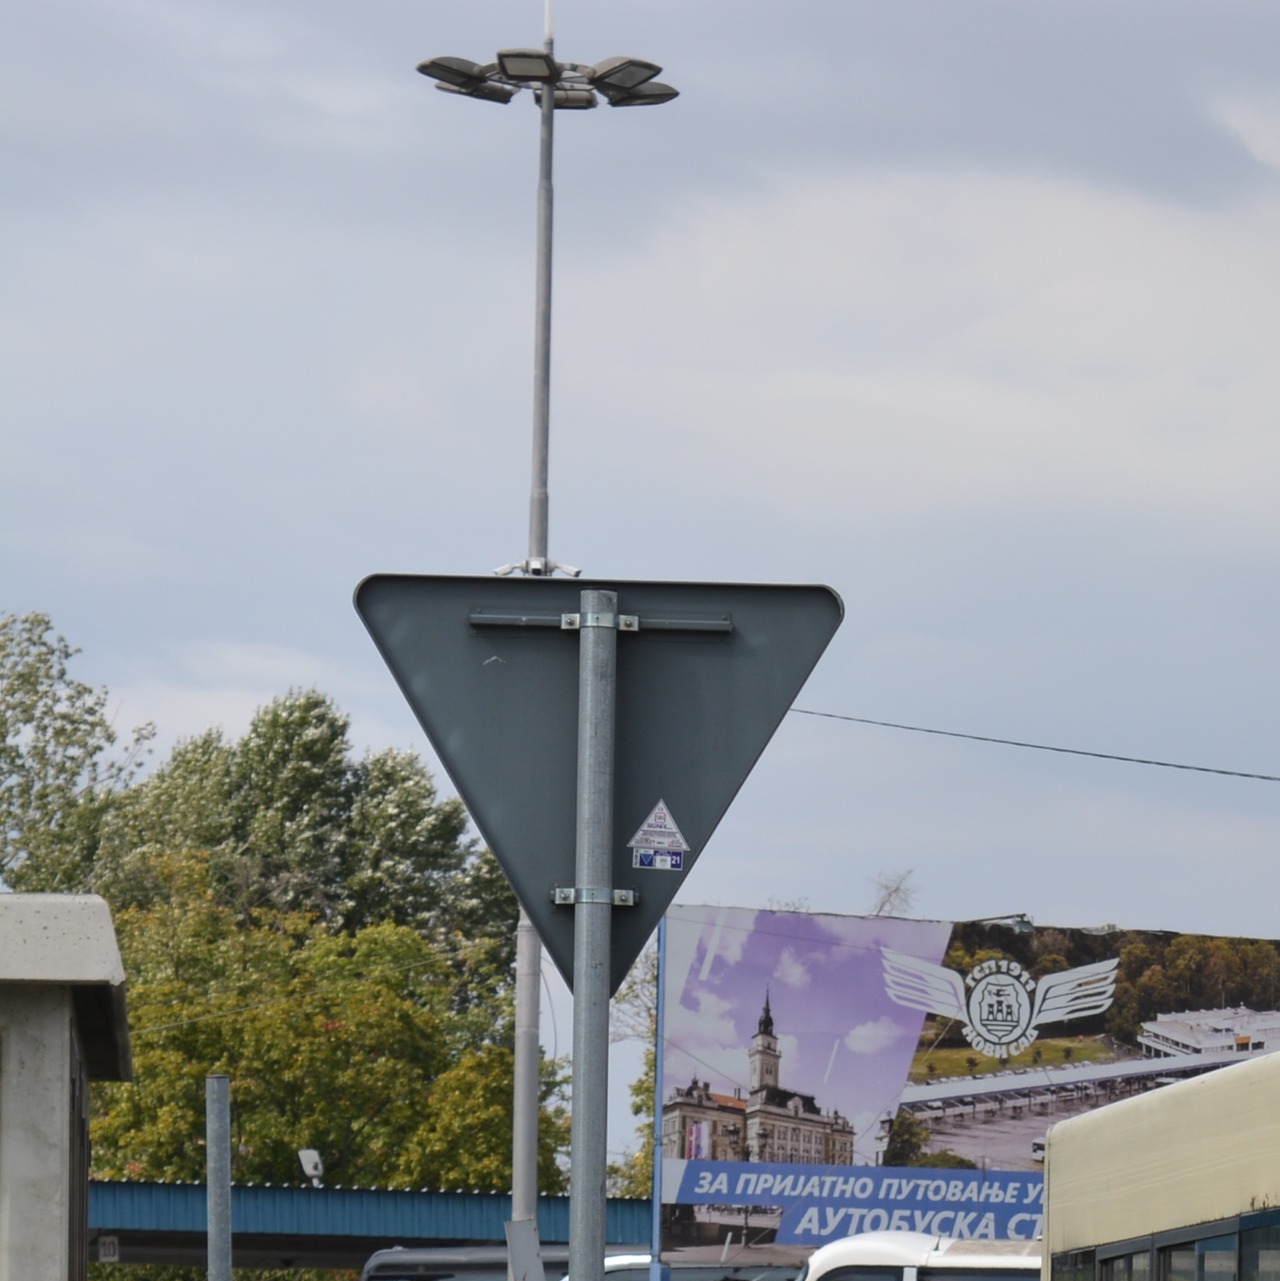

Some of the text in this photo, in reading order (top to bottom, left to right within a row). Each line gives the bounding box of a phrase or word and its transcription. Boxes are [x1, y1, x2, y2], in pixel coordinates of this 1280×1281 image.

[998, 959, 1037, 992] 1911
[961, 1023, 1009, 1060] НОВИ
[694, 1171, 729, 1195] ЗА
[735, 1173, 875, 1199] ПРИЈАТНО
[878, 1178, 1021, 1204] ПУТОВАЊЕ
[794, 1206, 997, 1241] АУТОБУСКА
